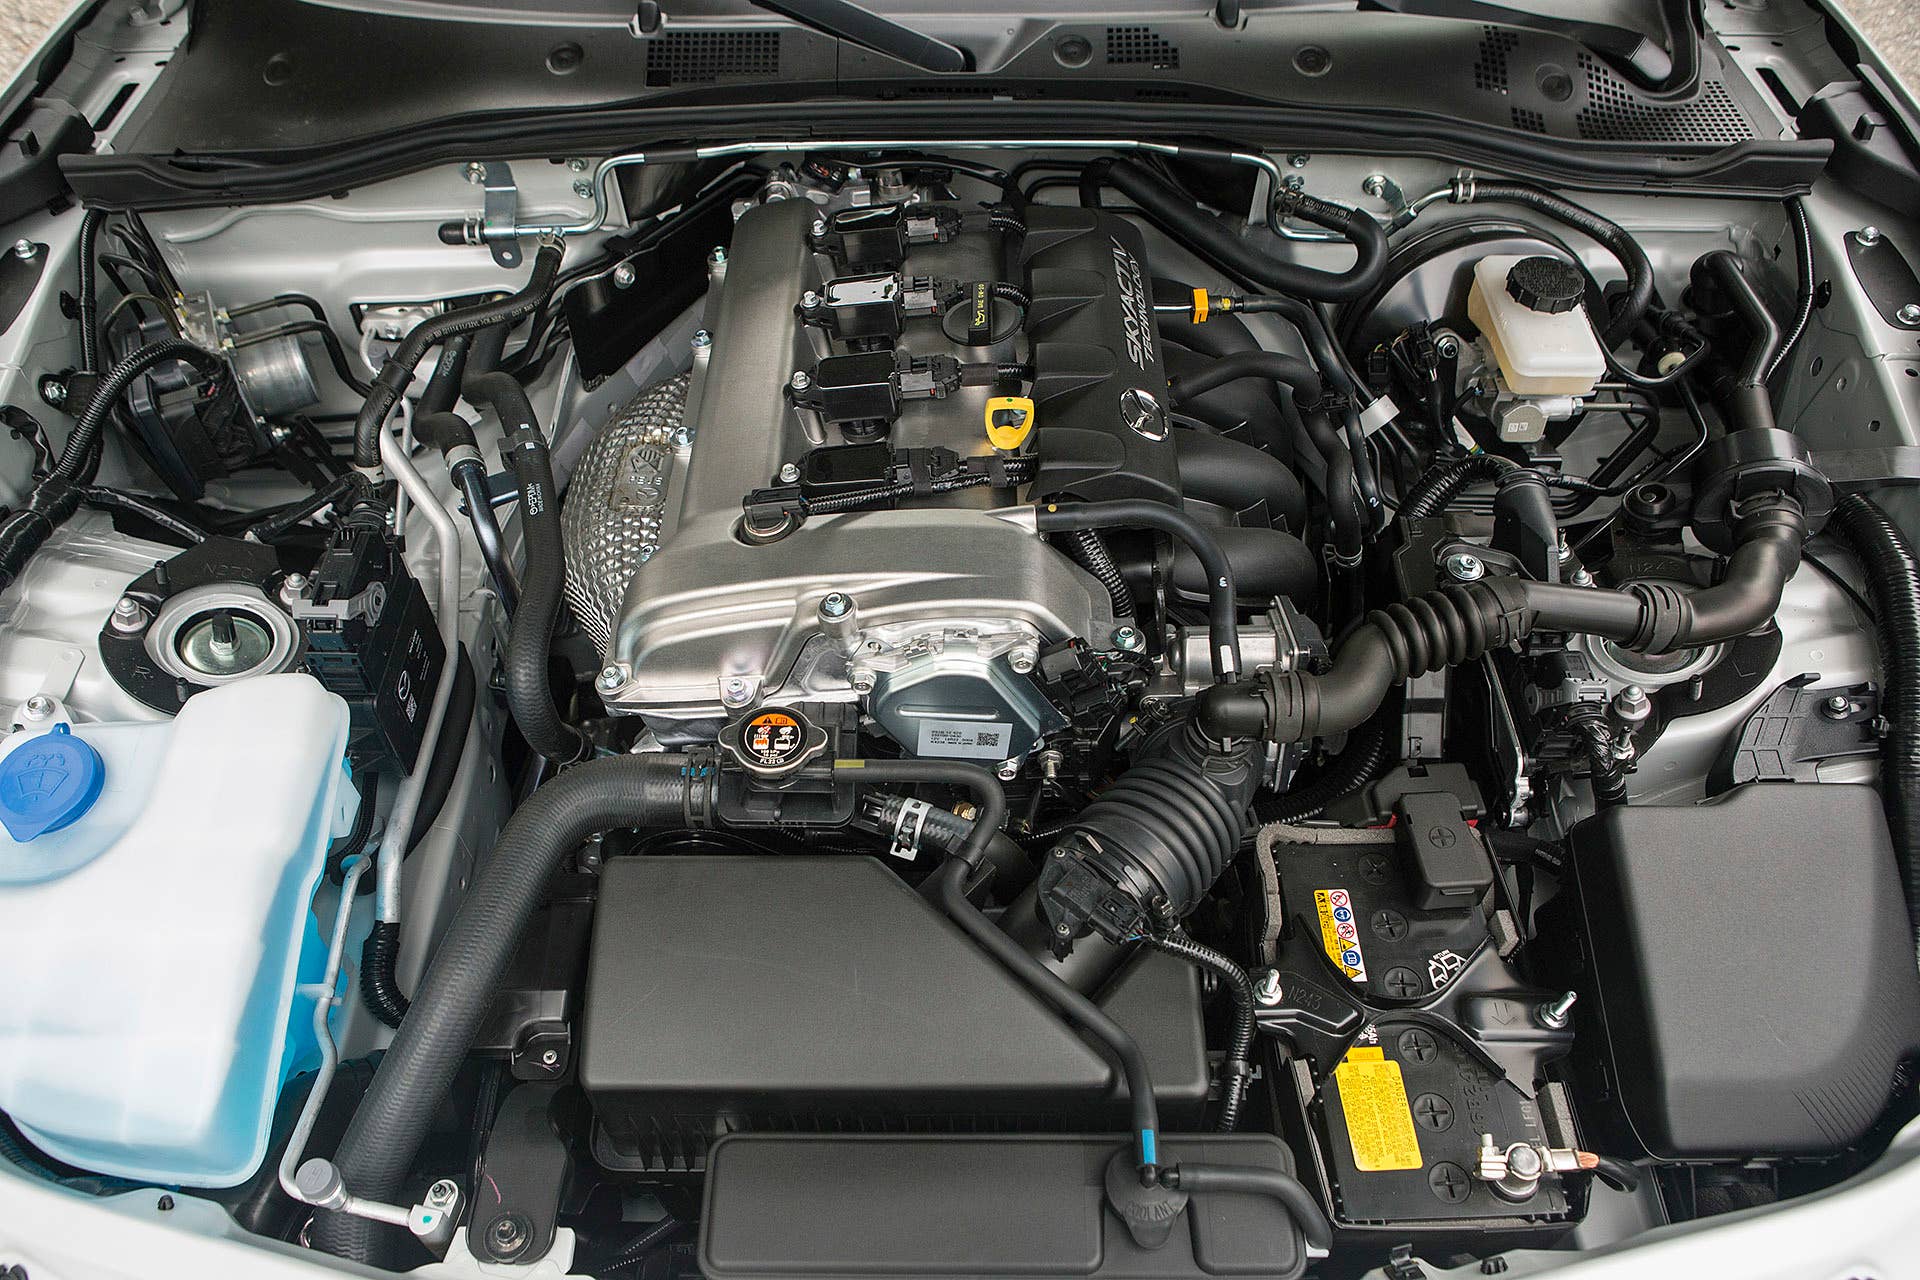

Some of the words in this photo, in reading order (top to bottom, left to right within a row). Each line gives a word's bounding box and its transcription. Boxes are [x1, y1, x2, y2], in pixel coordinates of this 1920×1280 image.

[1110, 235, 1145, 371] SKYACTIV
[1127, 251, 1155, 363] TECHNOLOGY
[1360, 1074, 1373, 1101] POISON
[1391, 1075, 1407, 1108] DANGER
